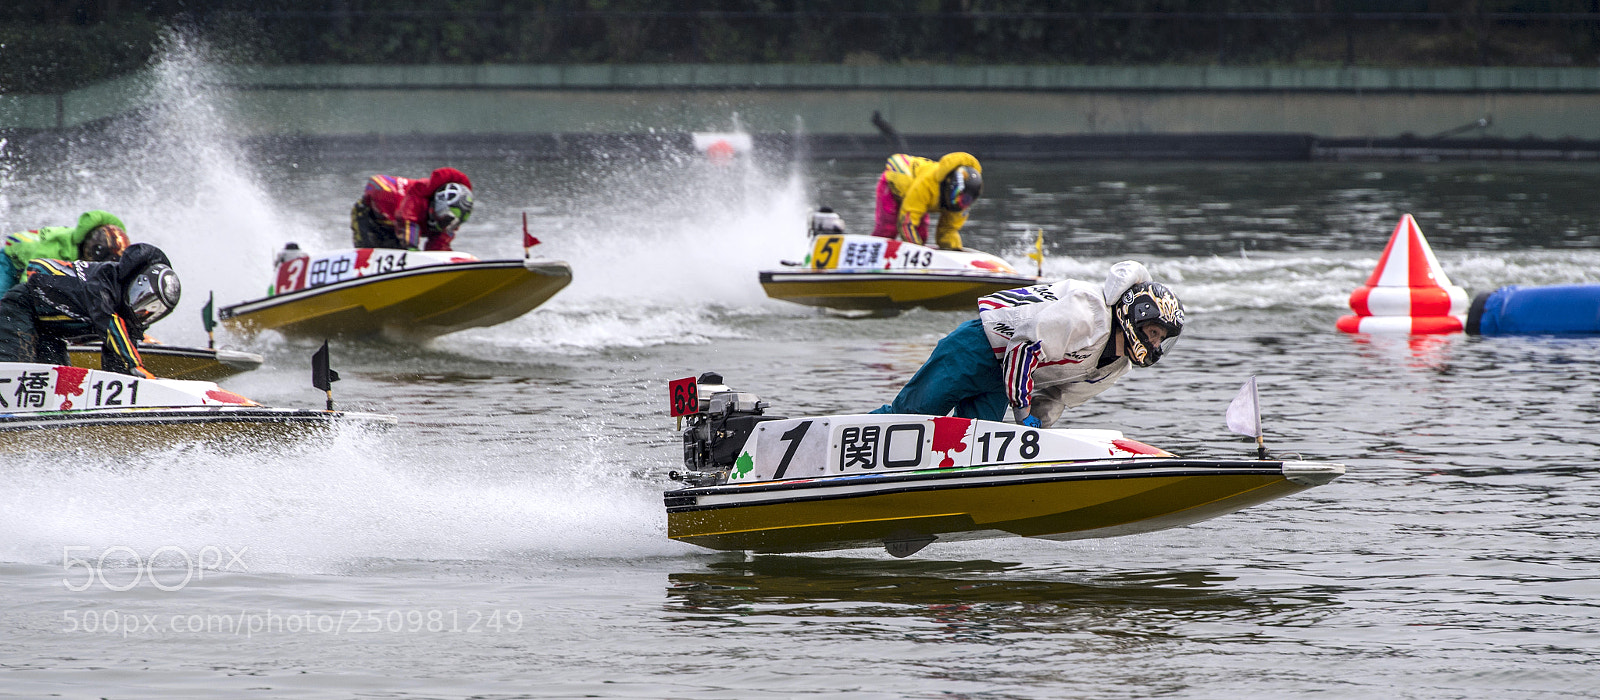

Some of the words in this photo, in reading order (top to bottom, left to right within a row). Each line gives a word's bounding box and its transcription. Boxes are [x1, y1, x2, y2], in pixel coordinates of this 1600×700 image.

[375, 252, 408, 274] 134
[816, 238, 840, 268] 5
[903, 250, 933, 268] 143
[280, 257, 305, 293] 3
[310, 255, 350, 287] 田中
[92, 380, 140, 407] 121
[674, 382, 698, 414] 68
[773, 421, 813, 479] 1
[839, 423, 925, 471] 関口
[977, 430, 1040, 463] 178
